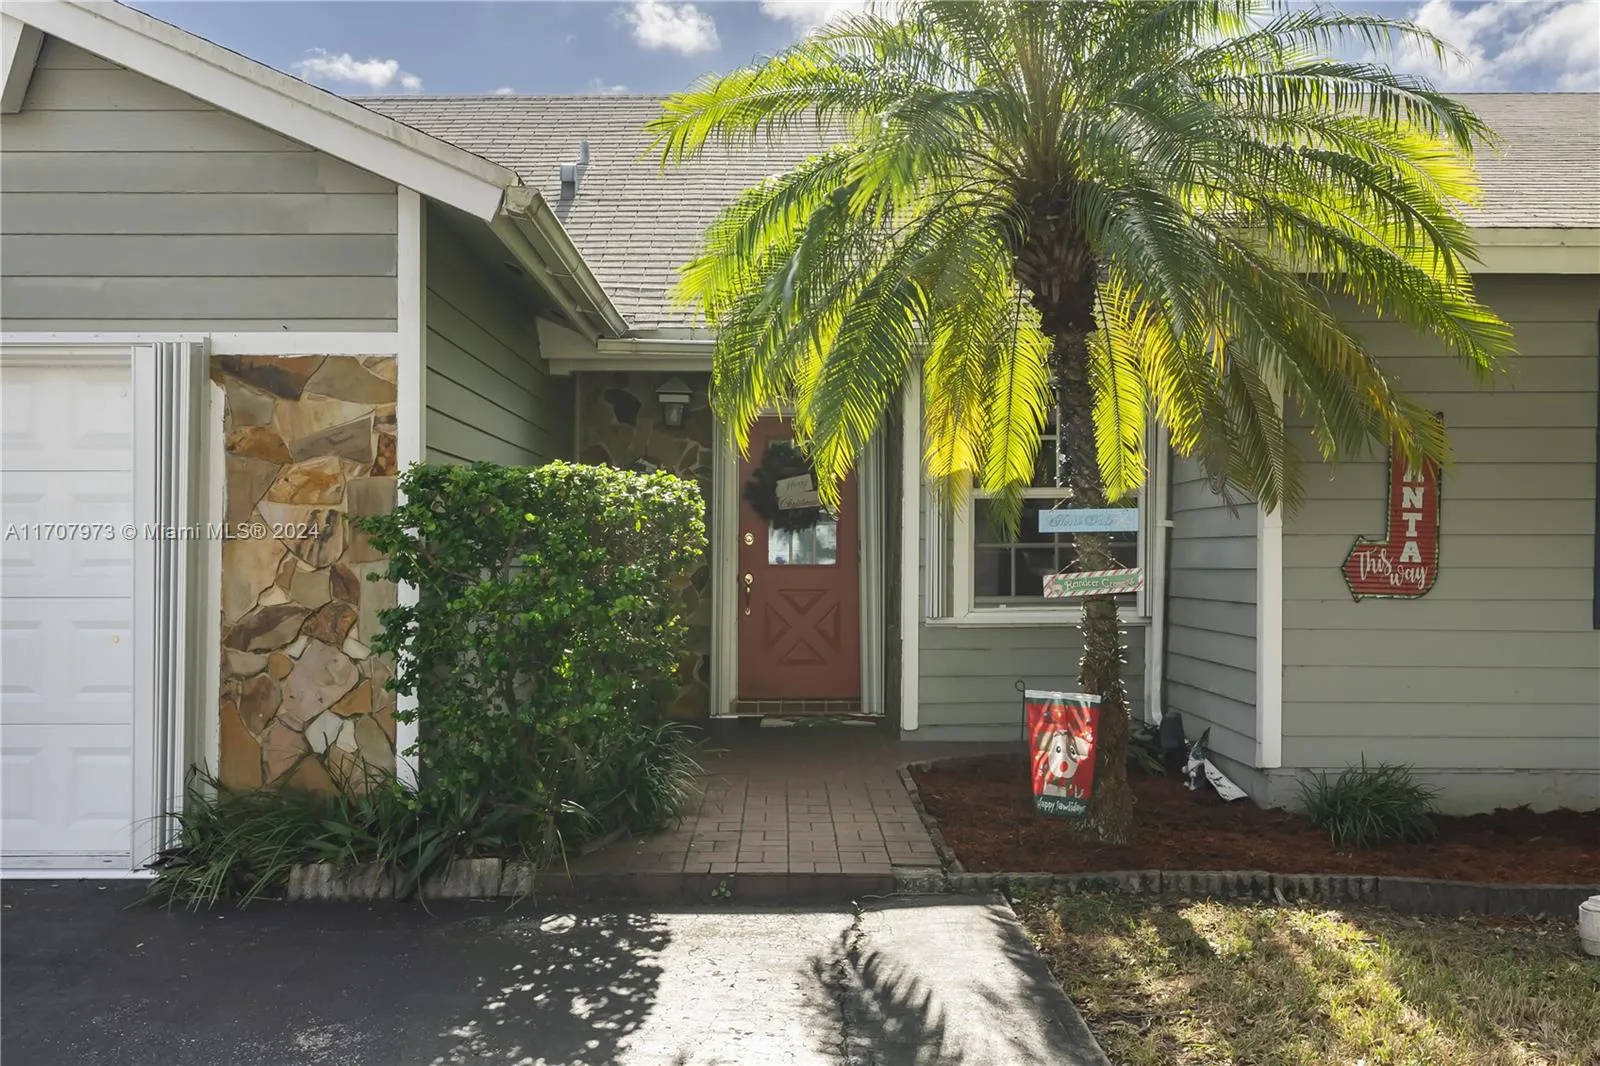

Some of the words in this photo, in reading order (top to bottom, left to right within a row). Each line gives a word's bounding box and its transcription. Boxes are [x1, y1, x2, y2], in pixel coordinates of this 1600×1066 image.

[1400, 465, 1425, 563] NTA
[1353, 546, 1394, 581] This
[1389, 565, 1428, 590] way
